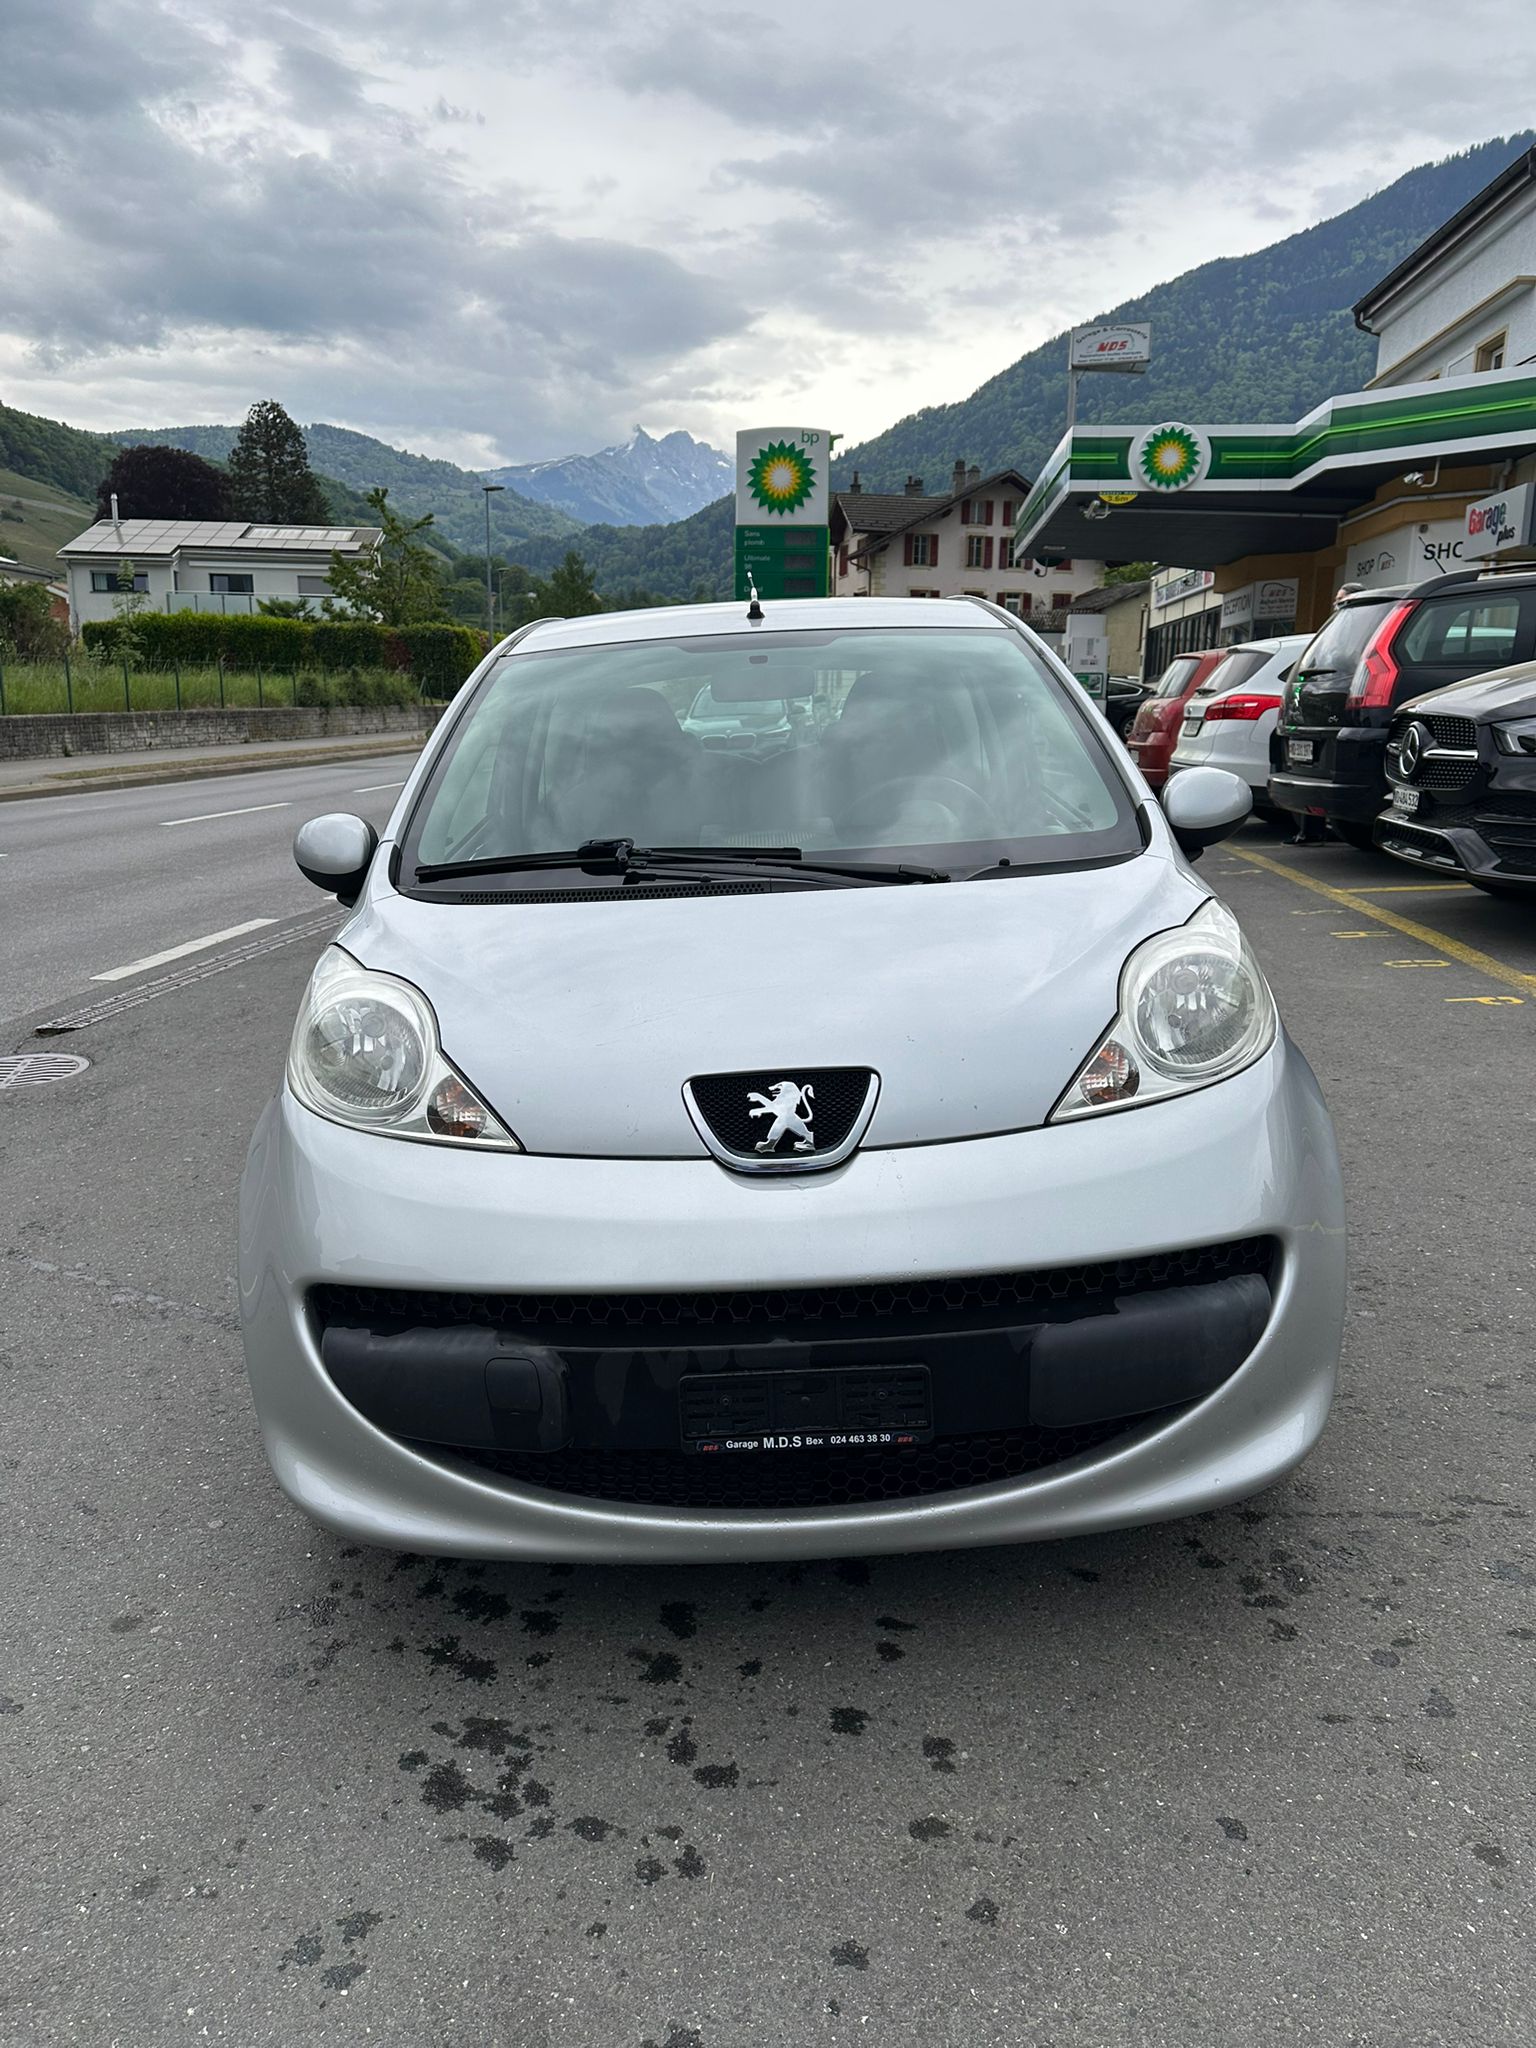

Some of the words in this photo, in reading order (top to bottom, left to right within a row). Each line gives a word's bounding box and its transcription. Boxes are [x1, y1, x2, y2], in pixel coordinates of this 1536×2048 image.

[801, 429, 820, 446] bp
[1468, 502, 1507, 536] Garage
[1495, 525, 1516, 547] plus
[1356, 558, 1375, 577] SHOP
[726, 1440, 758, 1450] Garage
[763, 1435, 802, 1449] M.D.S
[806, 1437, 824, 1446] Bex
[830, 1435, 847, 1445] 024
[848, 1434, 865, 1443] 463
[866, 1434, 878, 1443] 38
[880, 1433, 891, 1442] 30
